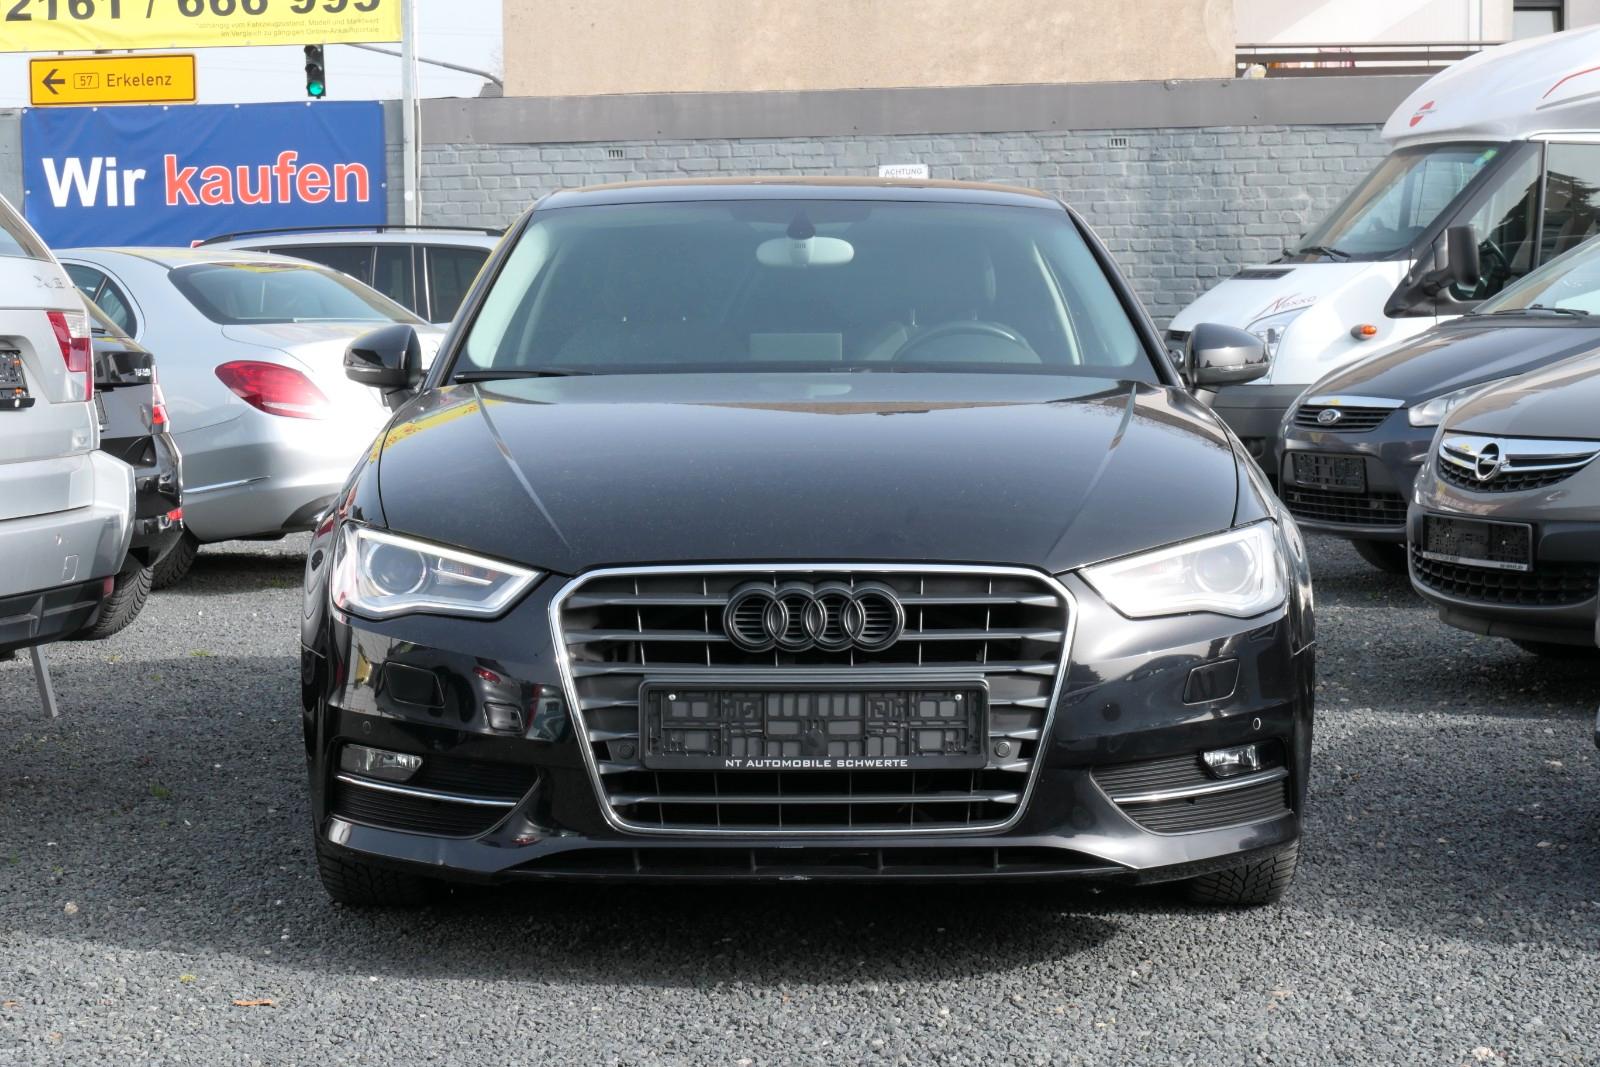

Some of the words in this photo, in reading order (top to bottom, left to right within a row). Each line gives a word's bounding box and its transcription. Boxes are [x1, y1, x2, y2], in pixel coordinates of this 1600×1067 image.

[79, 75, 93, 87] 57
[106, 72, 172, 88] Erkelenz
[884, 167, 923, 177] ACHTUNG
[42, 156, 146, 208] Wir
[163, 150, 370, 207] kaufen
[725, 759, 741, 769] NT
[746, 759, 832, 769] AUTOMOBILE
[837, 759, 908, 769] SCHWERTE
